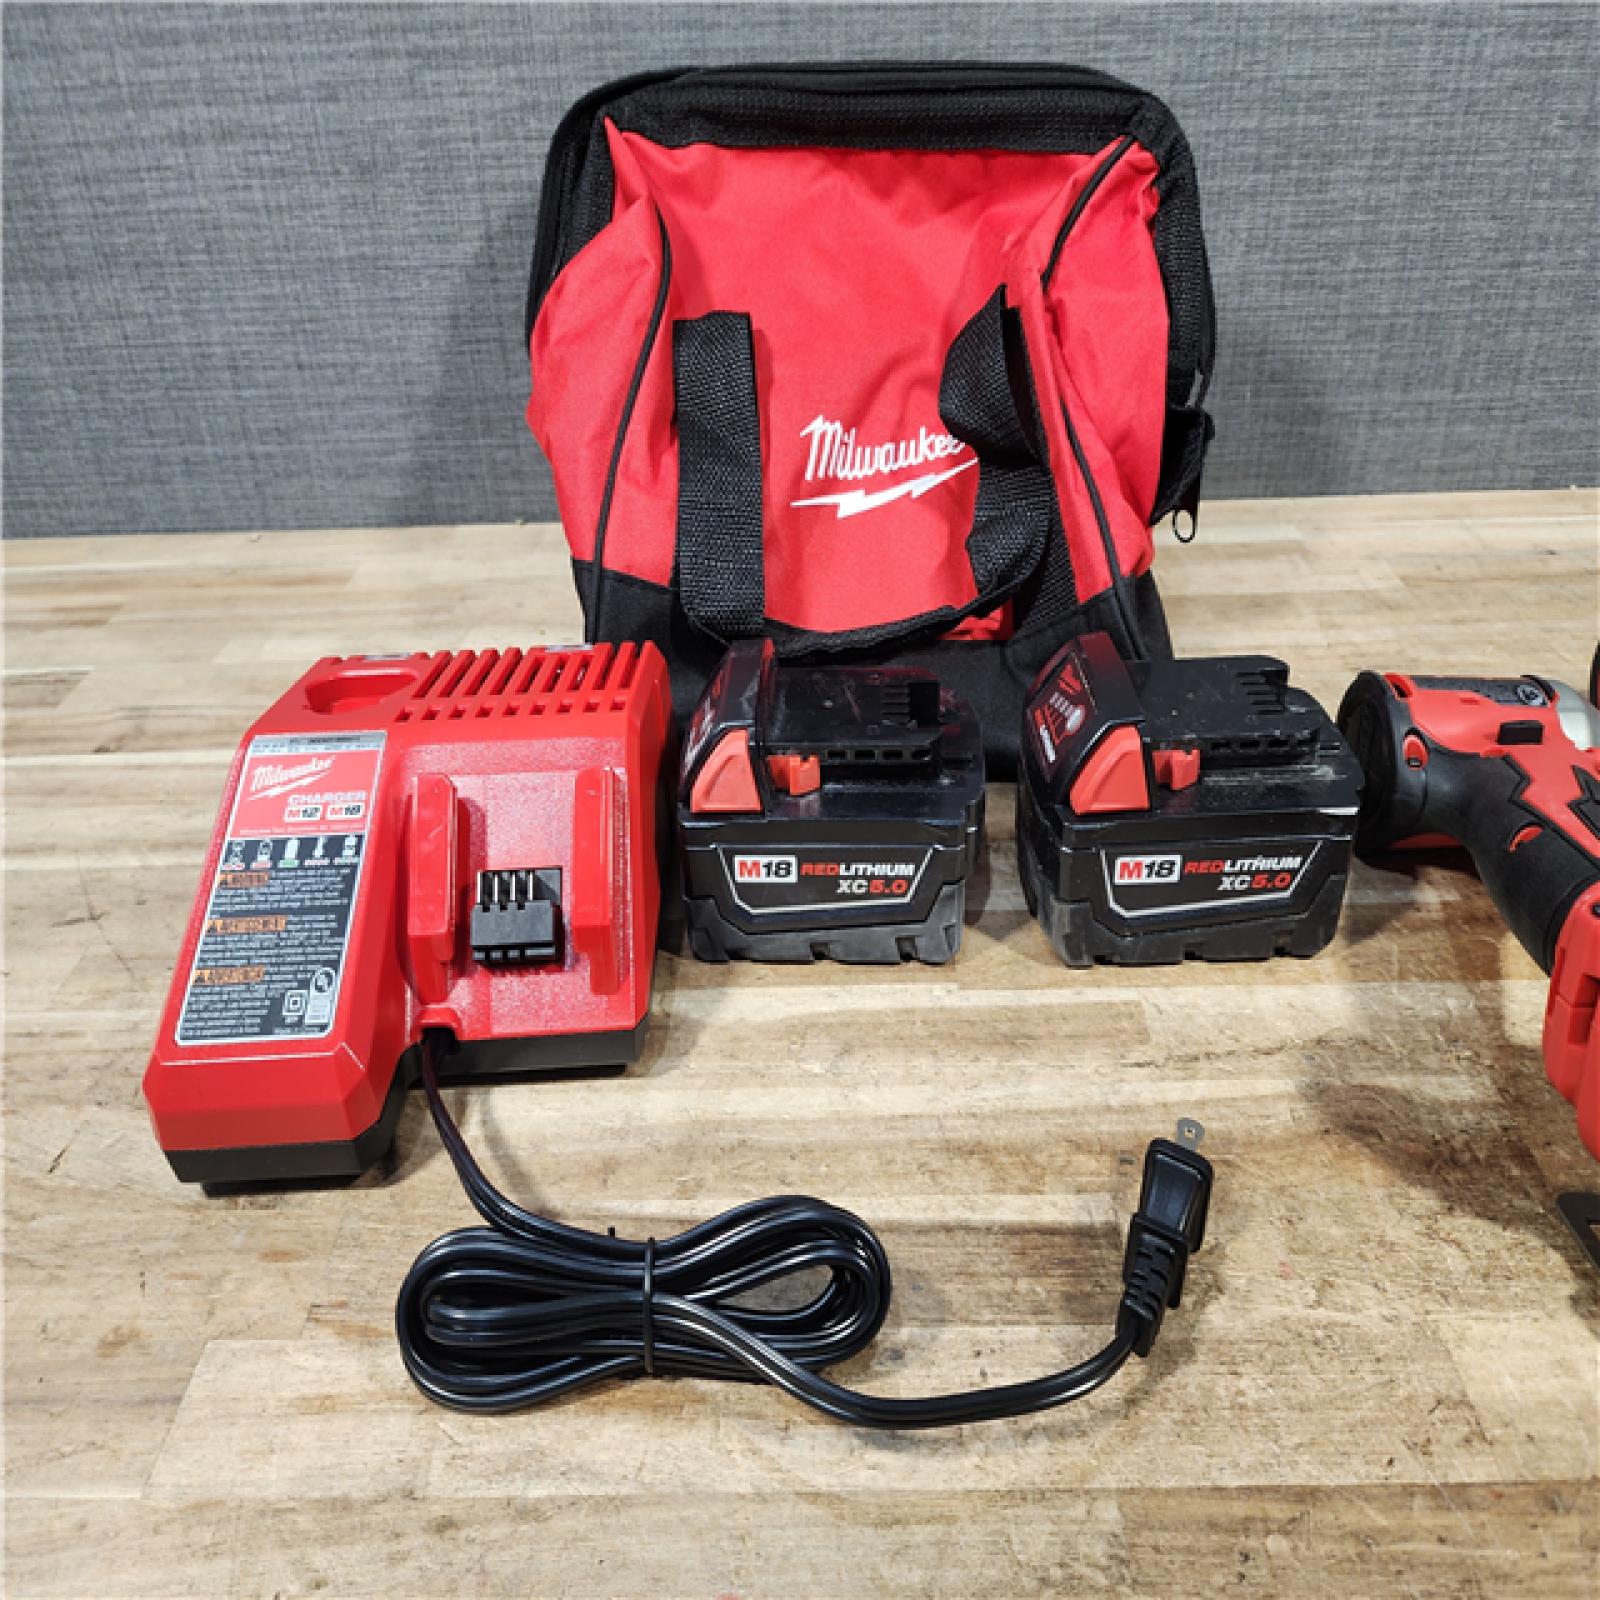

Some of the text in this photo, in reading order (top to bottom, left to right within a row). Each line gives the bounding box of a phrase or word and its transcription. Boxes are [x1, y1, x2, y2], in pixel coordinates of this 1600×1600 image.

[800, 414, 966, 481] Milwaukee
[738, 859, 915, 878] M18 REDLITHIUM
[1119, 856, 1302, 880] M18 REDLITHIUM
